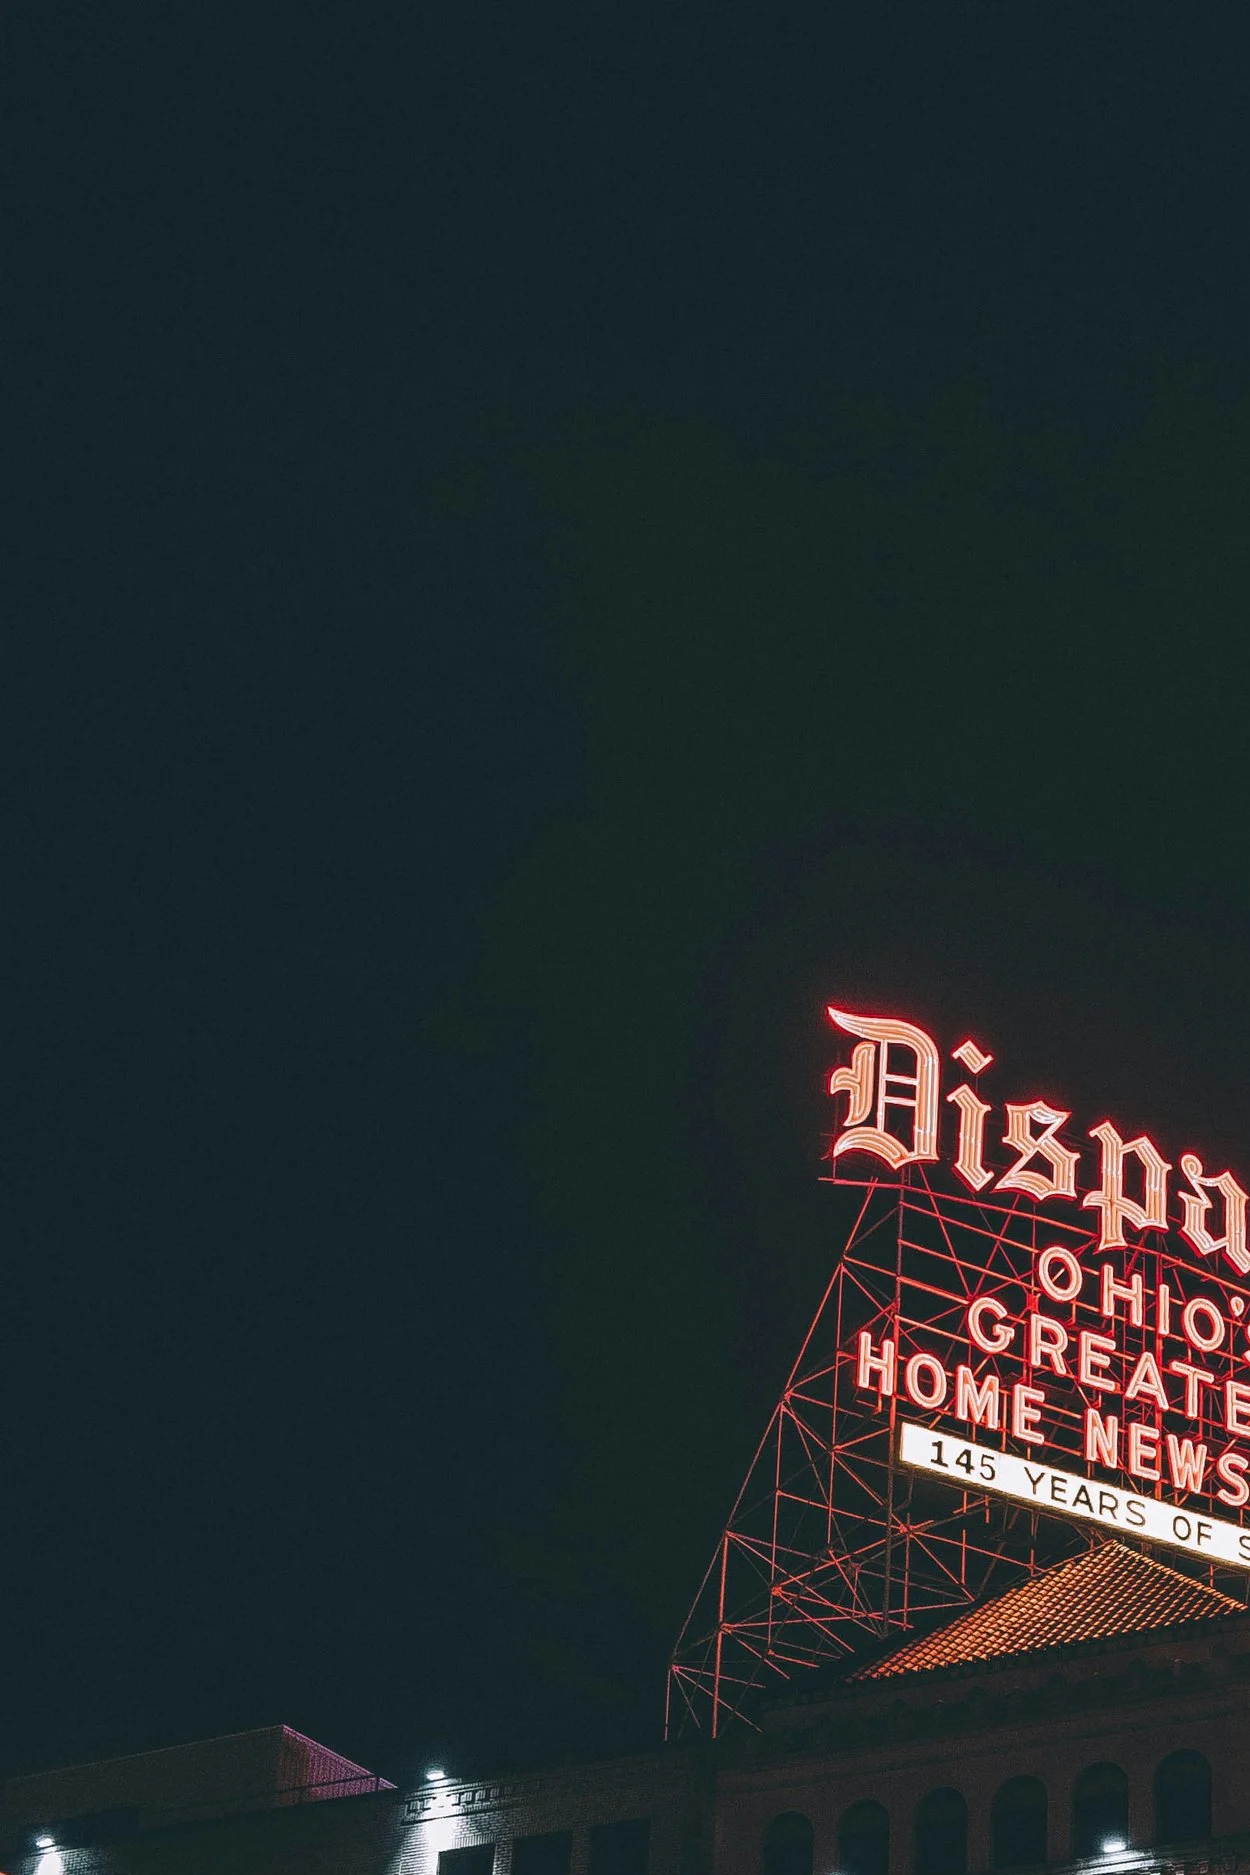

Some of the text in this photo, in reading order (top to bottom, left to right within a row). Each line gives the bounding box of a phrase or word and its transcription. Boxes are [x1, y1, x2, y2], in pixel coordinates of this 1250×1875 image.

[857, 1330, 1045, 1445] HOME
[930, 1440, 996, 1481] 145
[1023, 1466, 1147, 1527] YEARS
[1172, 1515, 1213, 1546] OF
